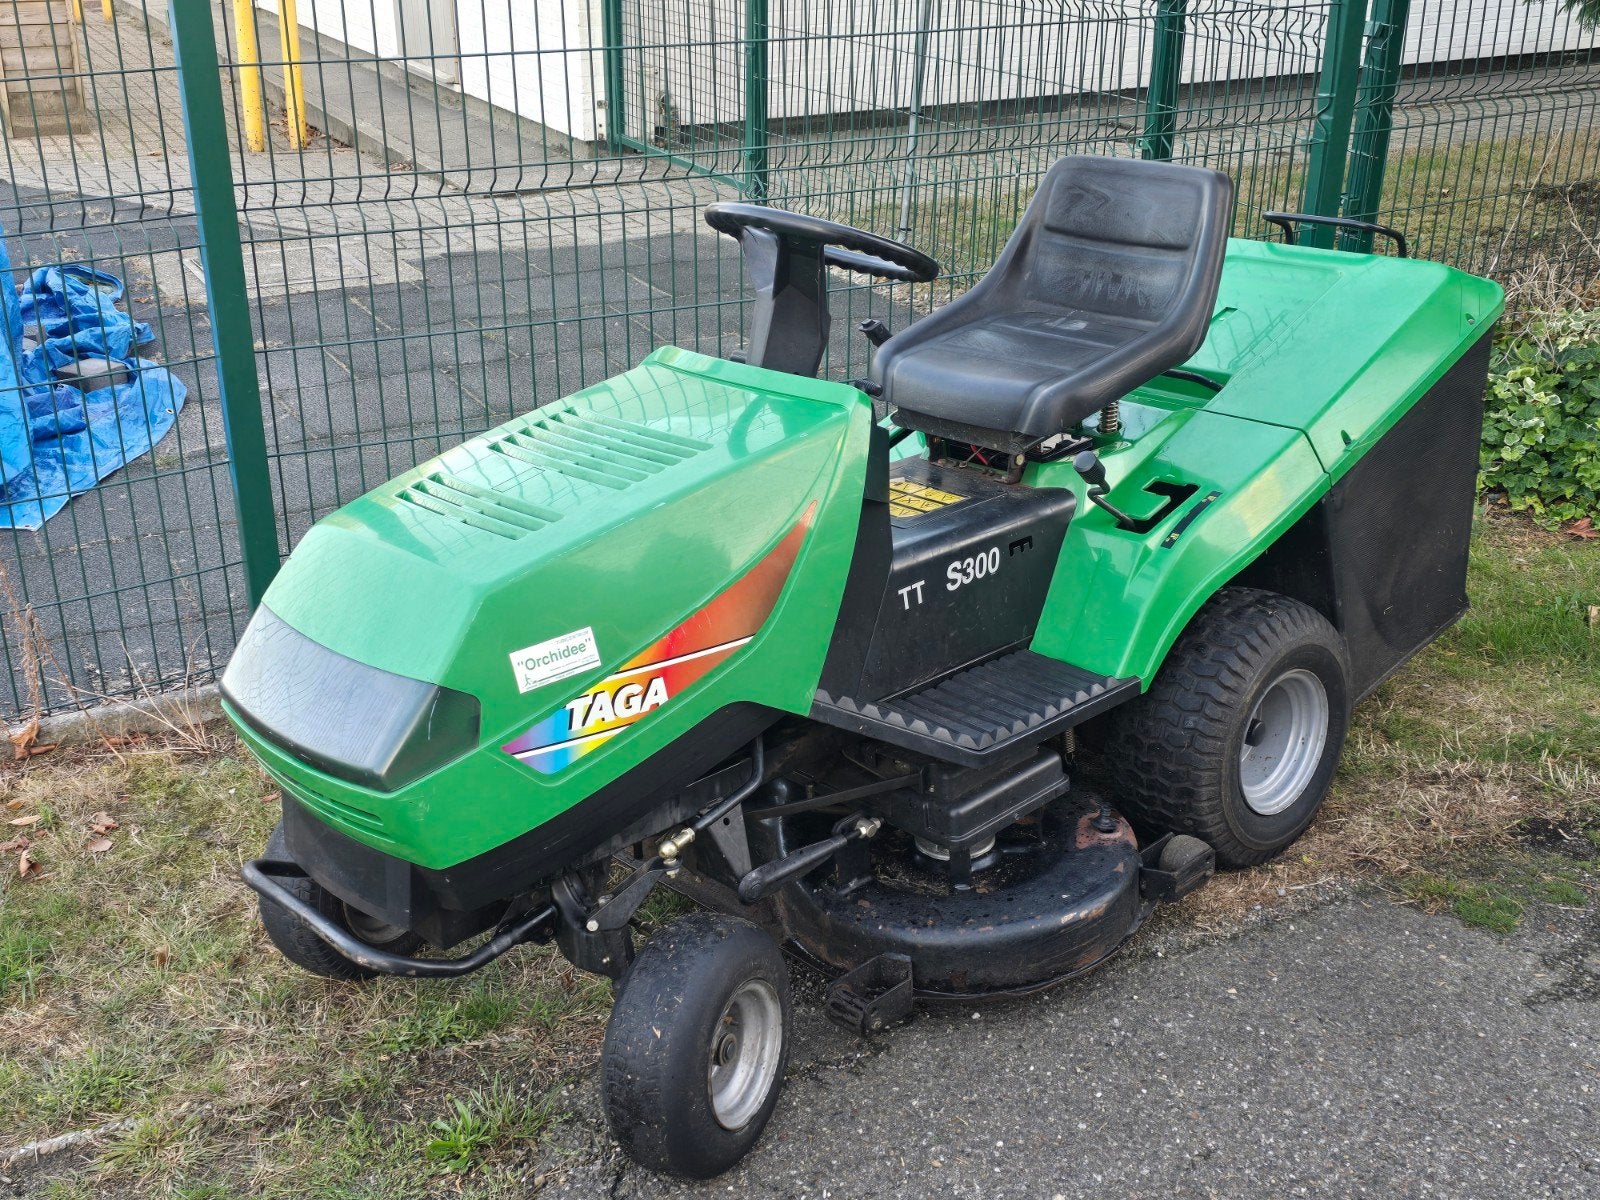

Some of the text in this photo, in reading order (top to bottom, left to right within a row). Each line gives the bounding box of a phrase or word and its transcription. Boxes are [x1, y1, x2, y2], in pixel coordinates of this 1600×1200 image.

[898, 546, 1000, 610] TT S300
[565, 677, 669, 732] TAGA
